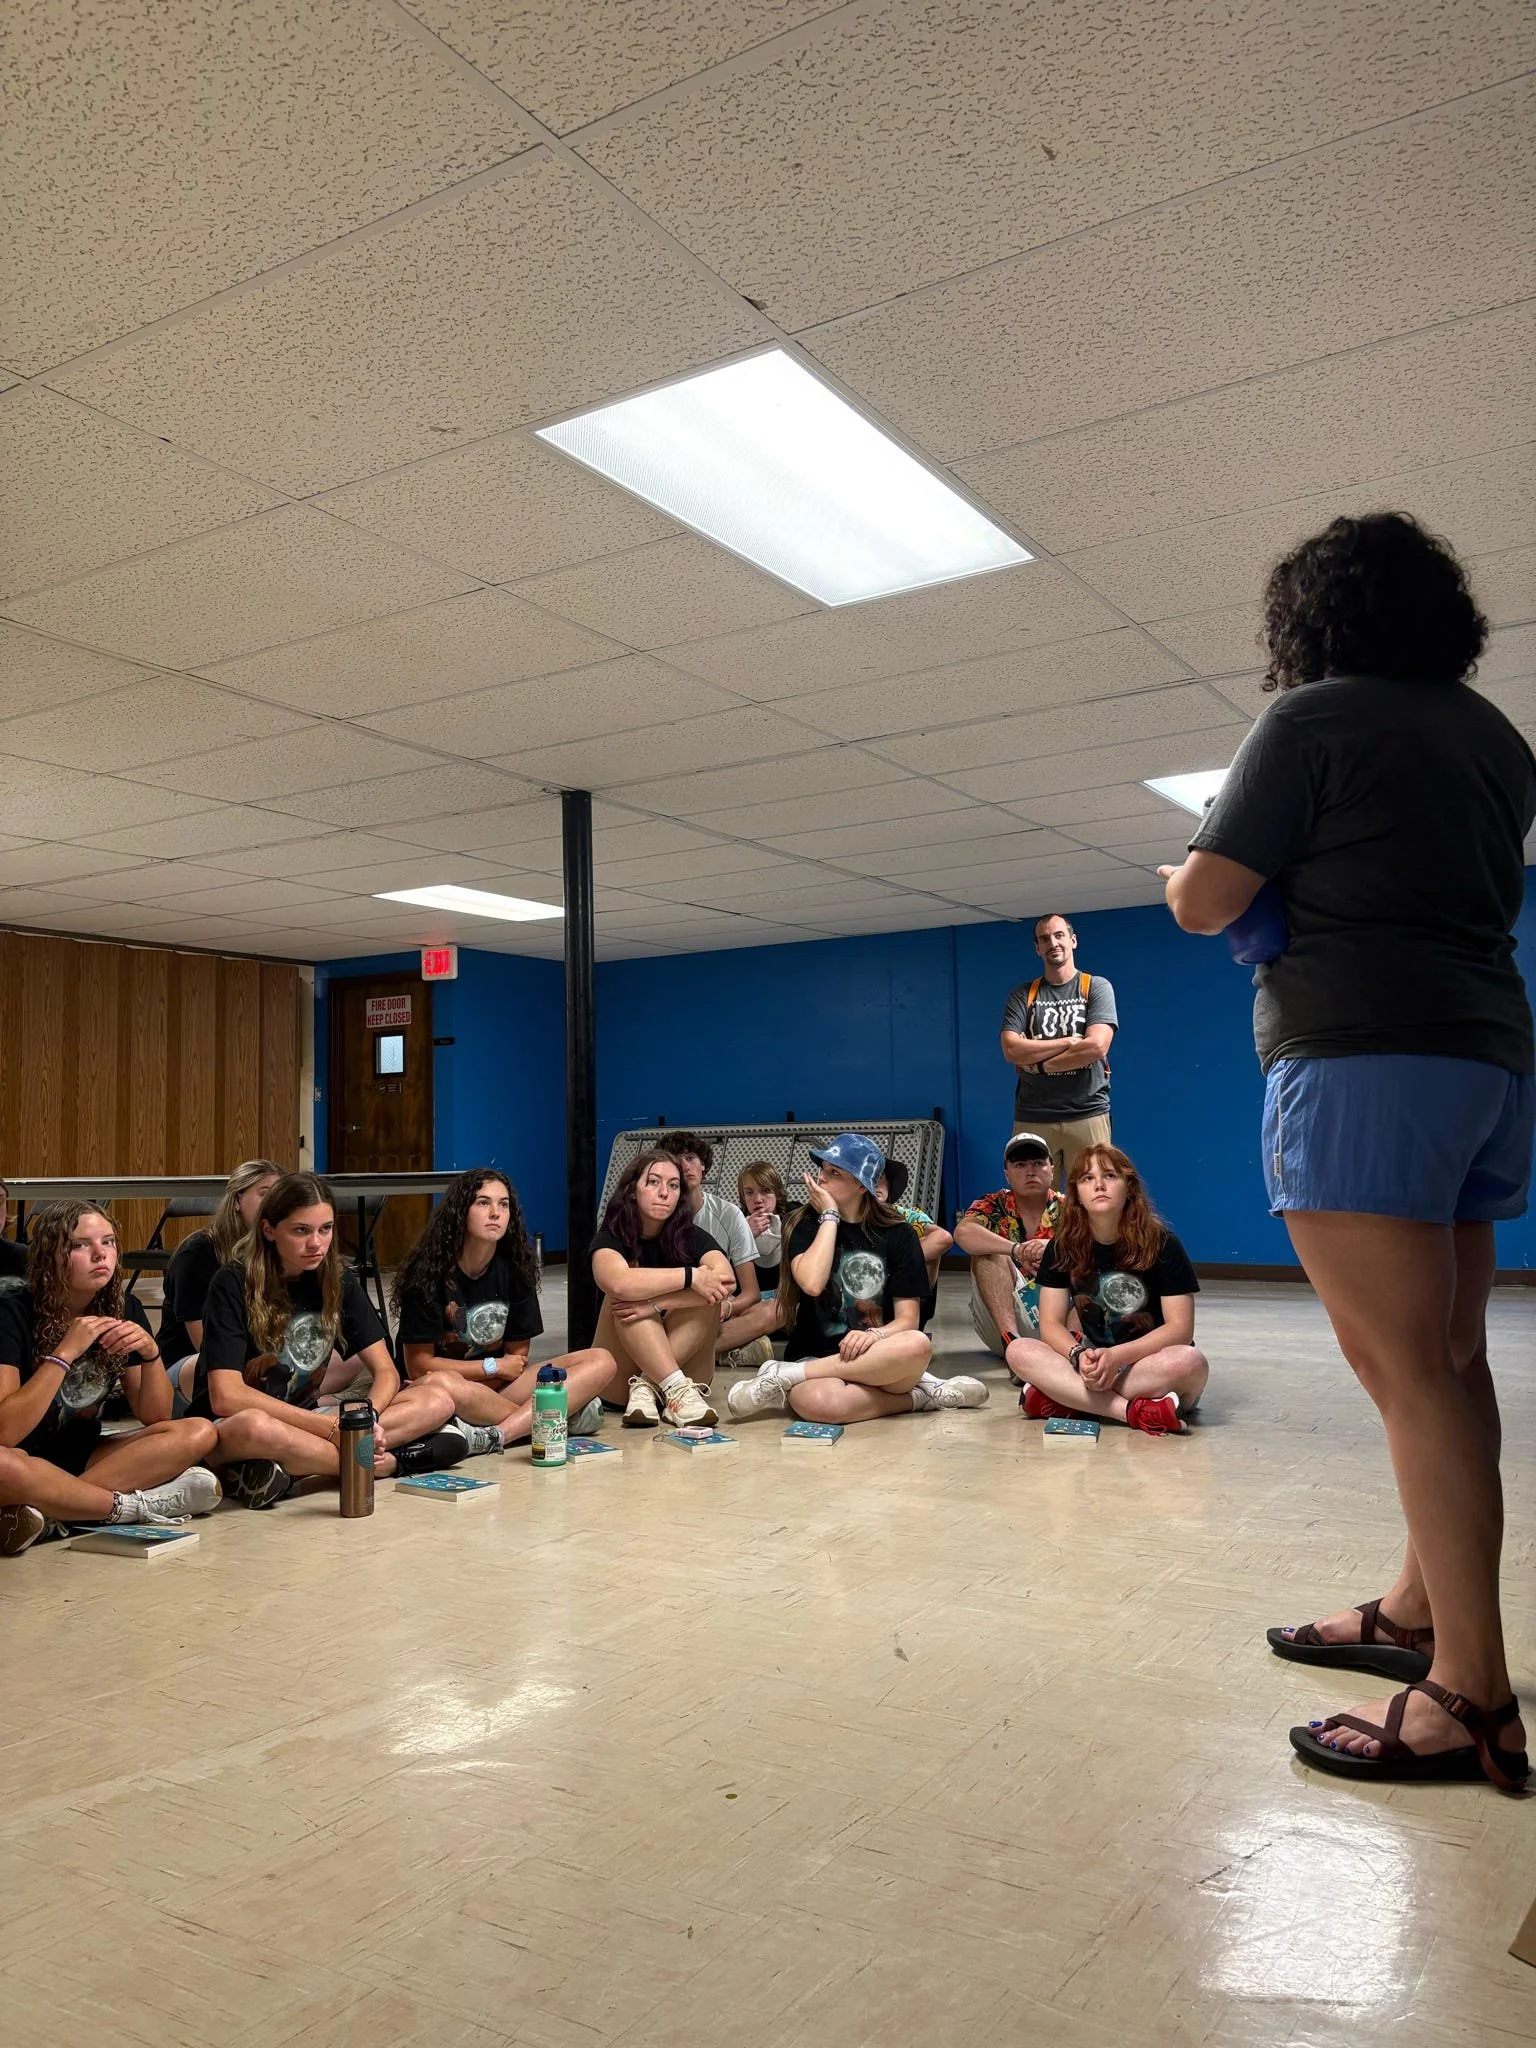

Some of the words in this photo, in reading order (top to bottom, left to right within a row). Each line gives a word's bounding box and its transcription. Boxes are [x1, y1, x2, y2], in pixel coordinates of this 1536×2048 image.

[425, 950, 450, 976] EXIT
[371, 999, 386, 1012] FIRE
[387, 997, 406, 1010] DOOR
[367, 1014, 383, 1026] KEEP
[384, 1012, 410, 1025] CLOSED
[1030, 1004, 1086, 1039] LOVE
